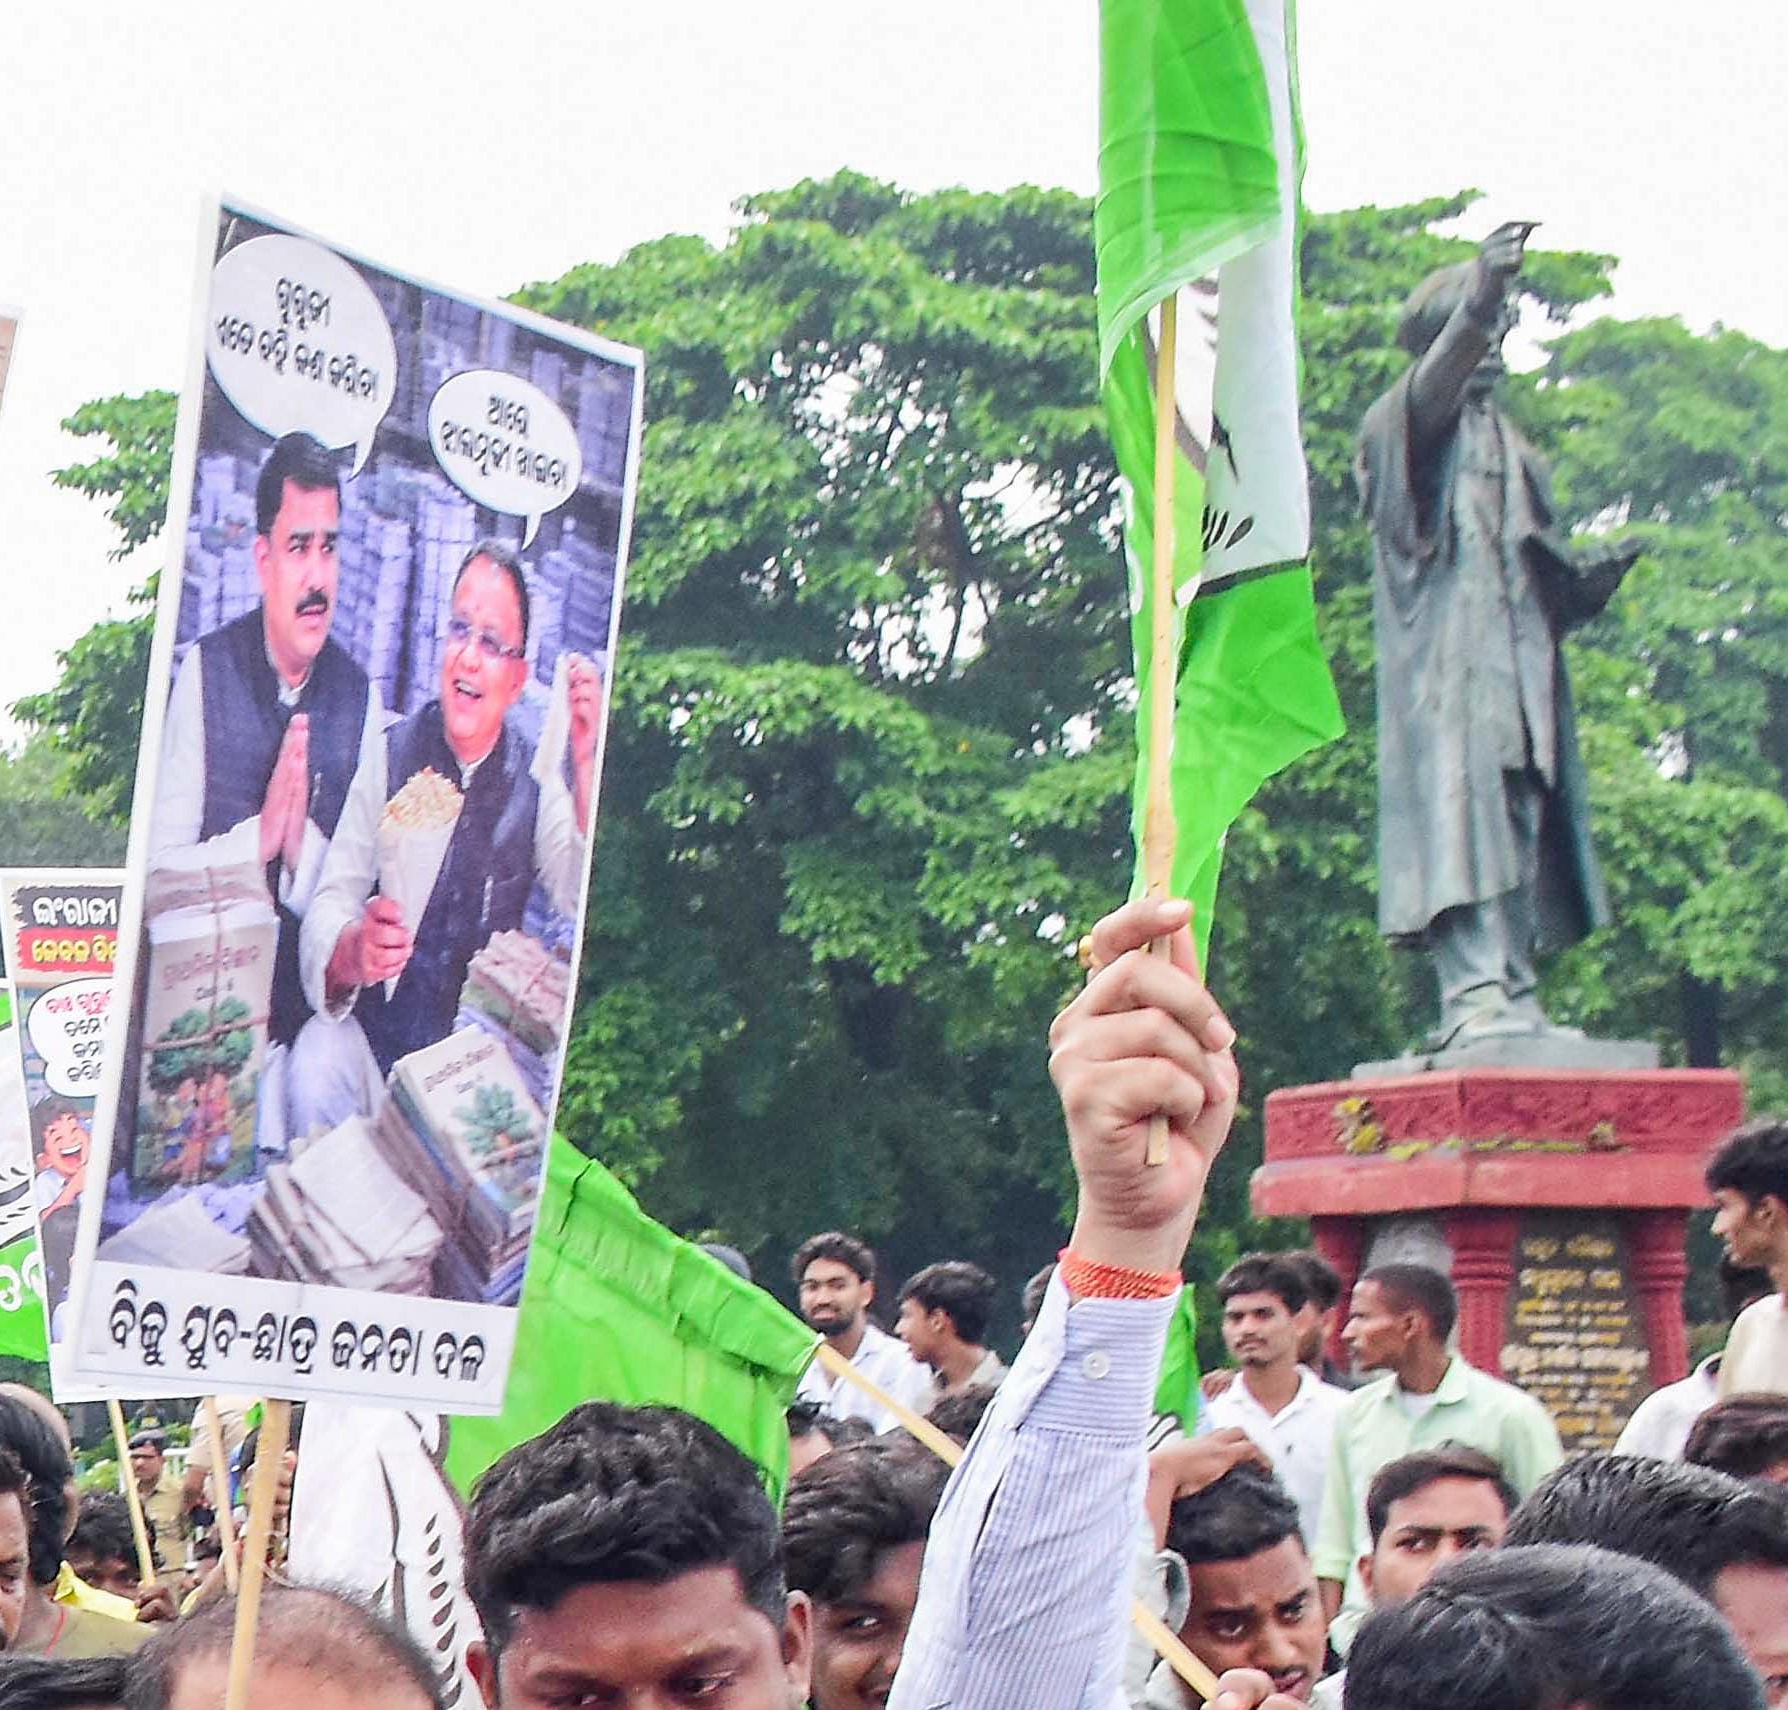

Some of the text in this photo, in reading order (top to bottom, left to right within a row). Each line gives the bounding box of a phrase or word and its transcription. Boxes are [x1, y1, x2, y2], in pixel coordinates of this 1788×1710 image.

[110, 1279, 168, 1367] ବିଜୁ
[331, 1321, 423, 1378] ଜନତା
[433, 1334, 485, 1383] ଦଳ
